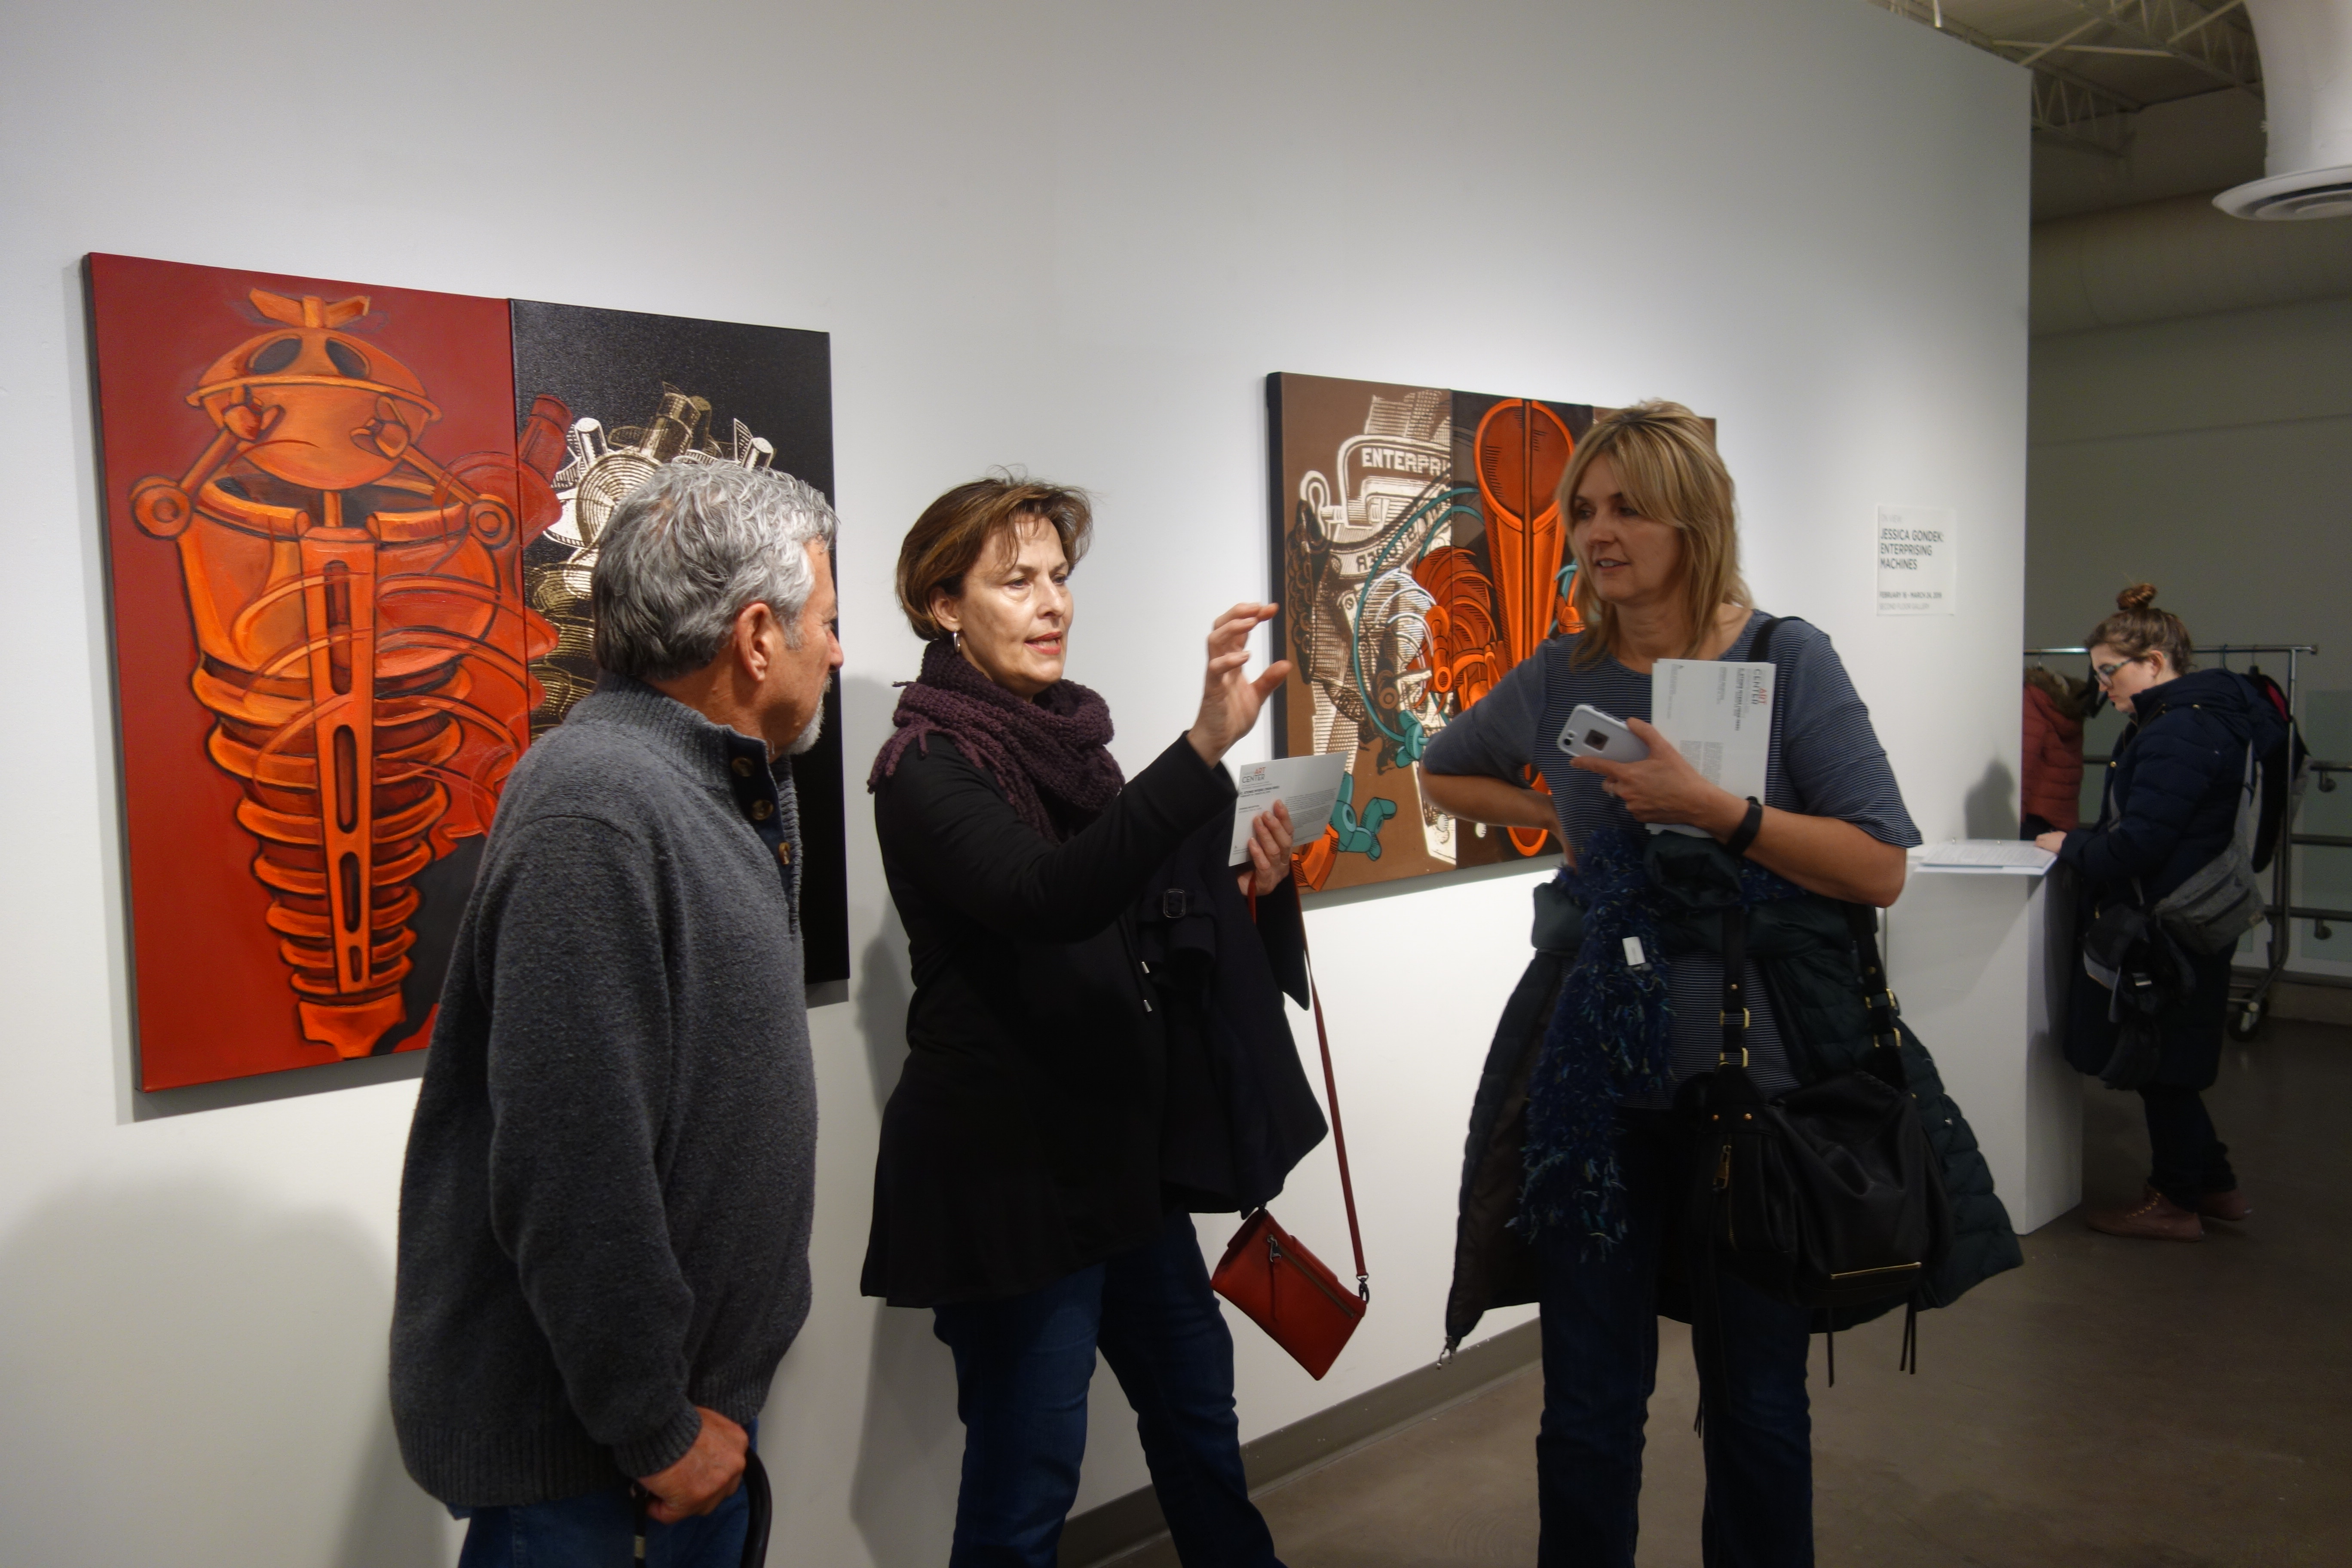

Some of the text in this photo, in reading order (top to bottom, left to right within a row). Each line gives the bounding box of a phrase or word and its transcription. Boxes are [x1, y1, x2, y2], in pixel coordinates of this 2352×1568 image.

[1881, 528, 1910, 541] JESSICA
[1880, 543, 1932, 556] ENTERPRISING
[1880, 558, 1917, 570] MACHINES
[1242, 774, 1265, 783] CENTER
